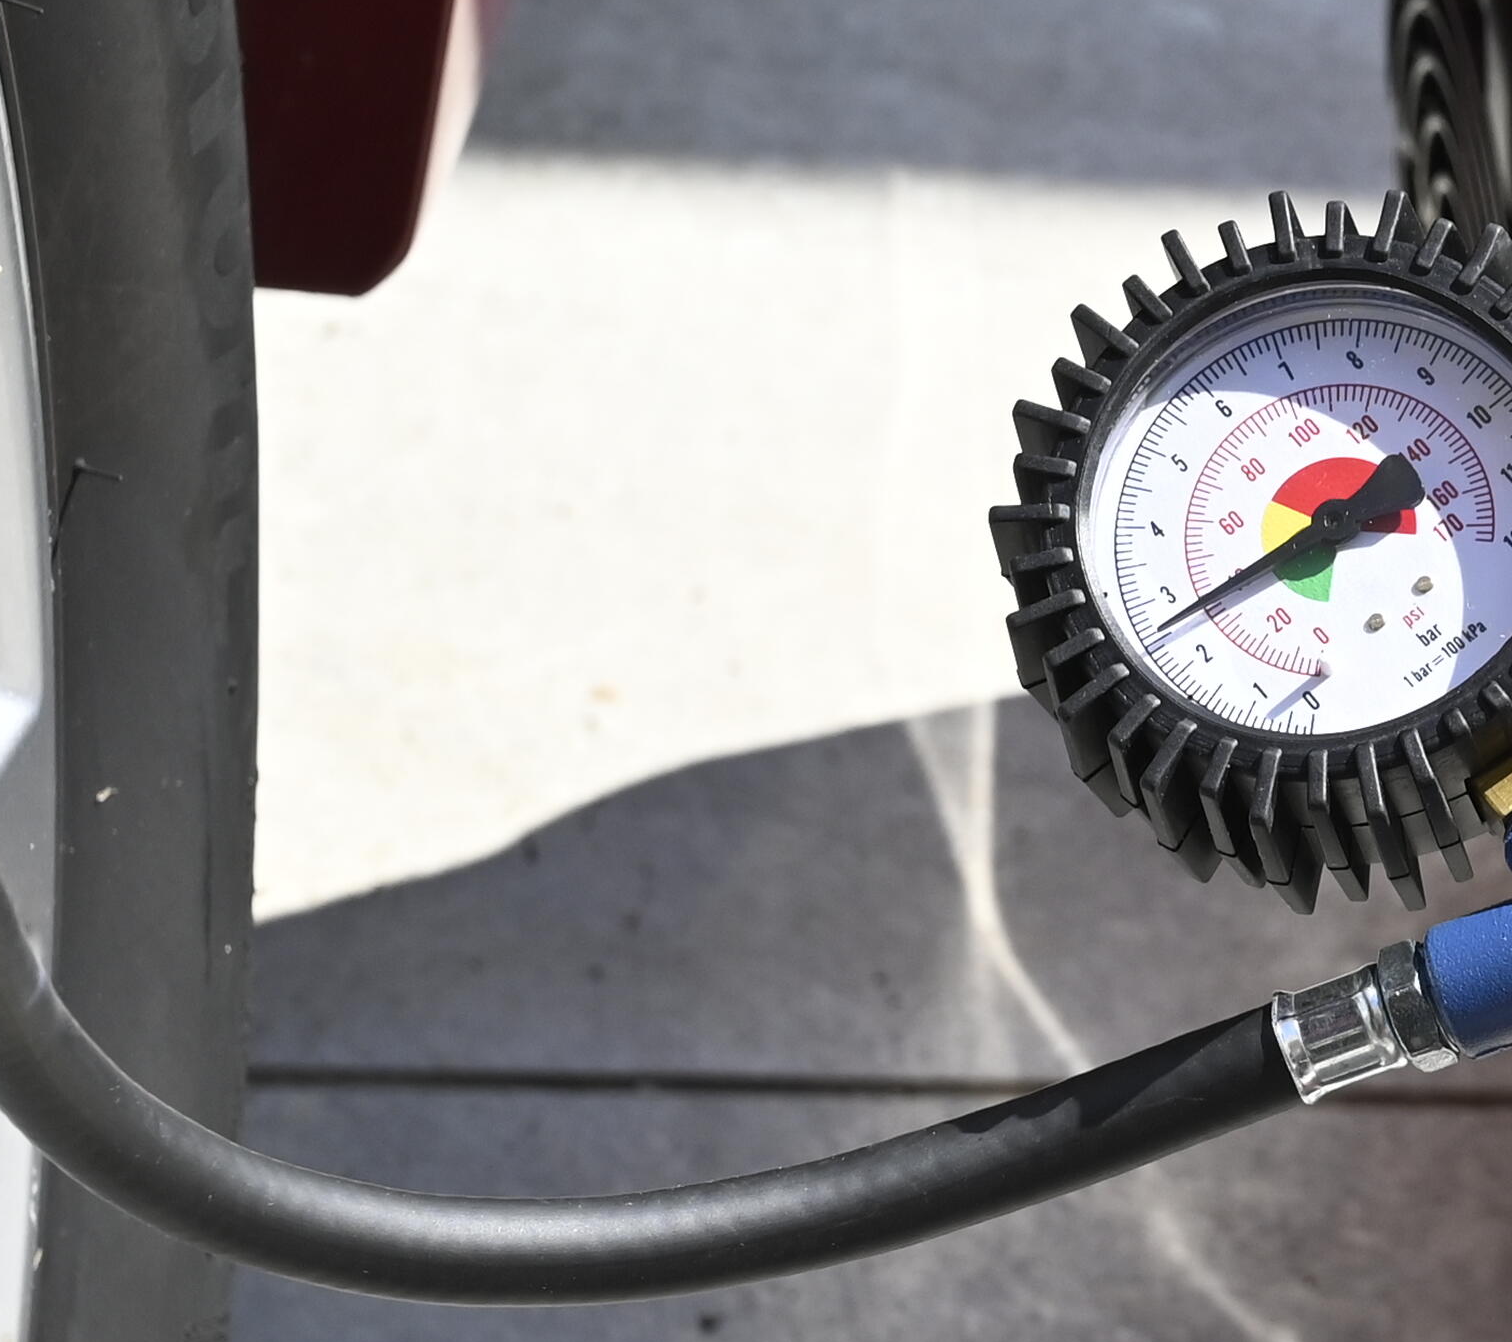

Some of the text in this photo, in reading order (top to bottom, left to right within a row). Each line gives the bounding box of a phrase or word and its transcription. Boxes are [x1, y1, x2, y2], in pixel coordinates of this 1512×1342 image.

[1346, 350, 1364, 369] 8
[1416, 366, 1435, 386] 9
[1215, 399, 1233, 418] 6
[1466, 404, 1492, 429] 10
[1288, 418, 1321, 448] 100
[1345, 414, 1379, 444] 120
[1399, 438, 1431, 462] 40
[1170, 453, 1188, 473] 5
[1240, 457, 1266, 482] 80
[1426, 480, 1459, 511] 160
[1150, 521, 1165, 537] 4
[1218, 510, 1244, 535] 60
[1432, 513, 1464, 542] 170
[1160, 586, 1177, 604] 3
[1266, 607, 1292, 633] 20
[1402, 606, 1425, 629] psi
[1312, 627, 1330, 644] 0
[1415, 624, 1442, 647] bar
[1195, 644, 1214, 663] 2
[1411, 662, 1433, 682] bar
[1441, 636, 1466, 658] 100
[1461, 622, 1487, 642] kPa
[1253, 682, 1268, 699] 1
[1302, 690, 1320, 710] 0
